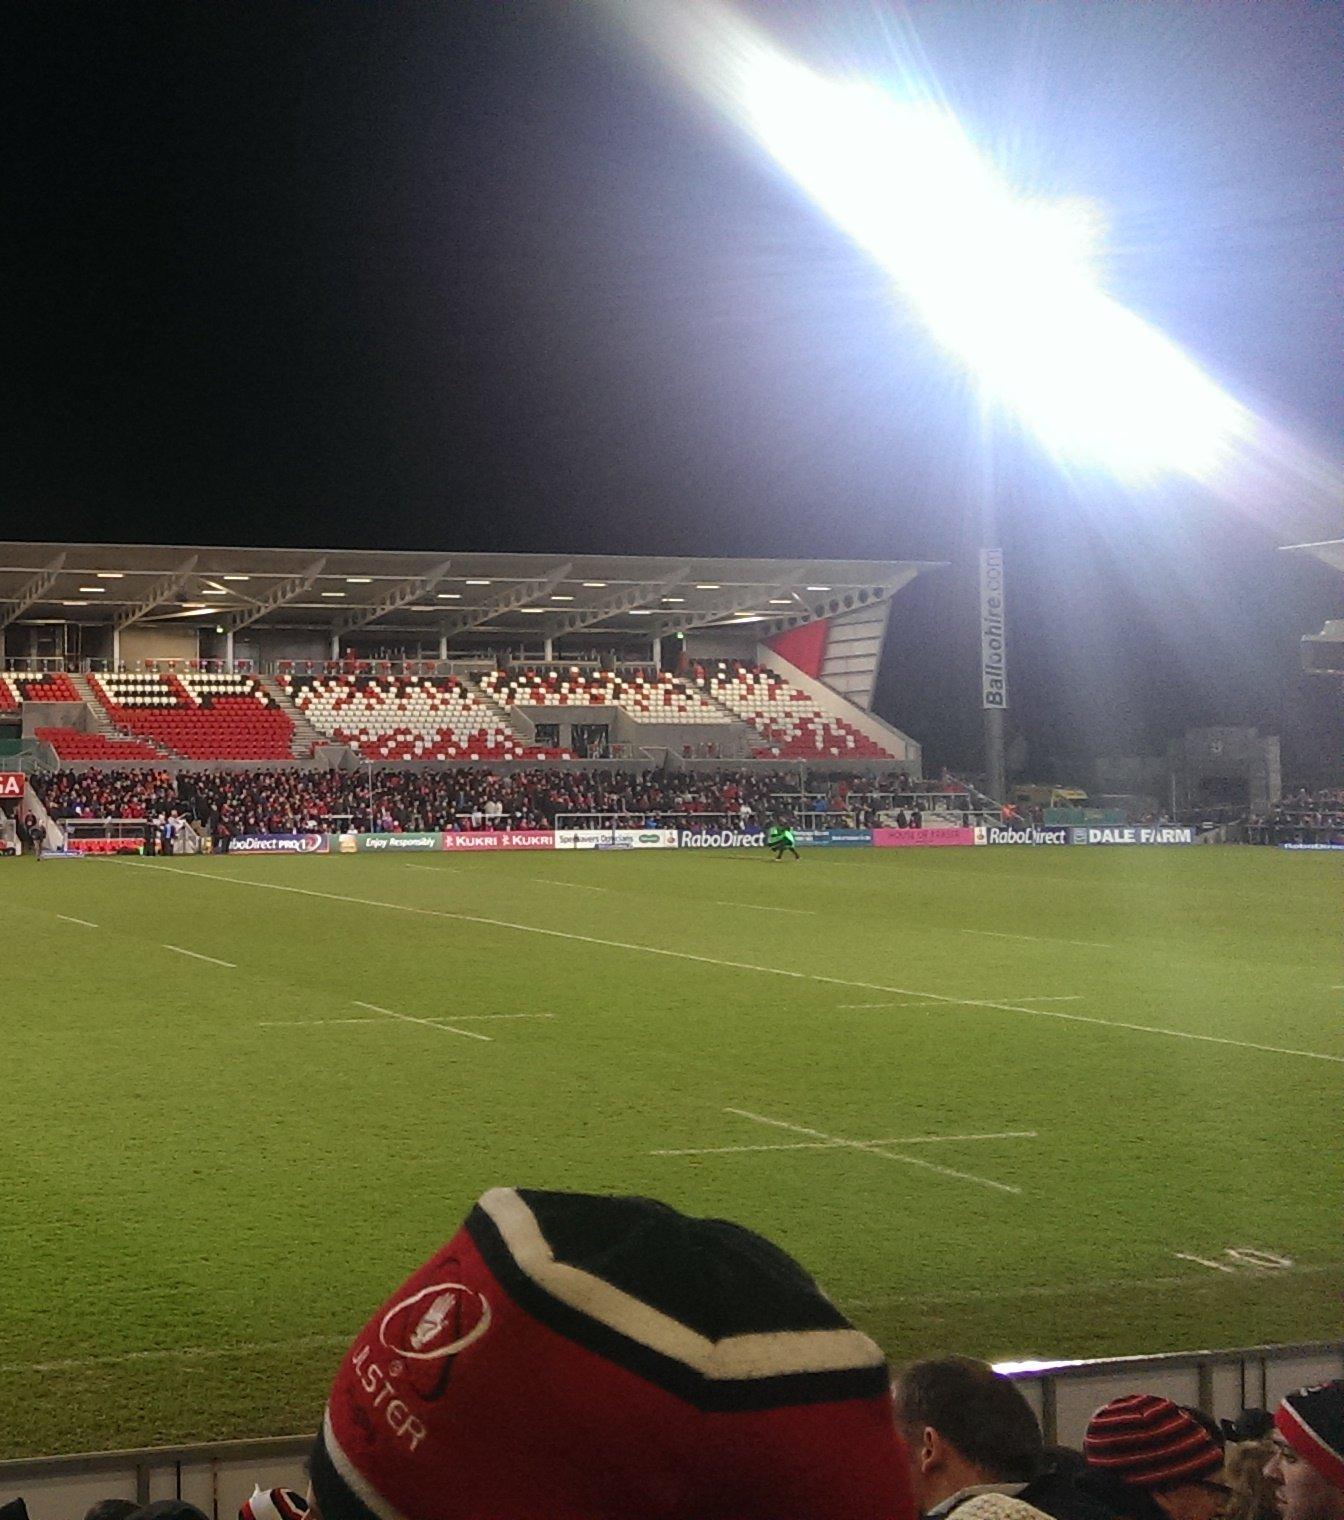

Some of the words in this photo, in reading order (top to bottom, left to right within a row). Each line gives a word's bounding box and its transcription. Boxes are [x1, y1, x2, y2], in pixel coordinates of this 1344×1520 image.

[456, 835, 497, 846] KUKRI
[512, 835, 553, 845] KUKRI
[682, 831, 765, 847] RaboDirect
[990, 827, 1065, 844] RaboDirect
[1089, 829, 1136, 842] DALE
[1141, 829, 1191, 842] FARM
